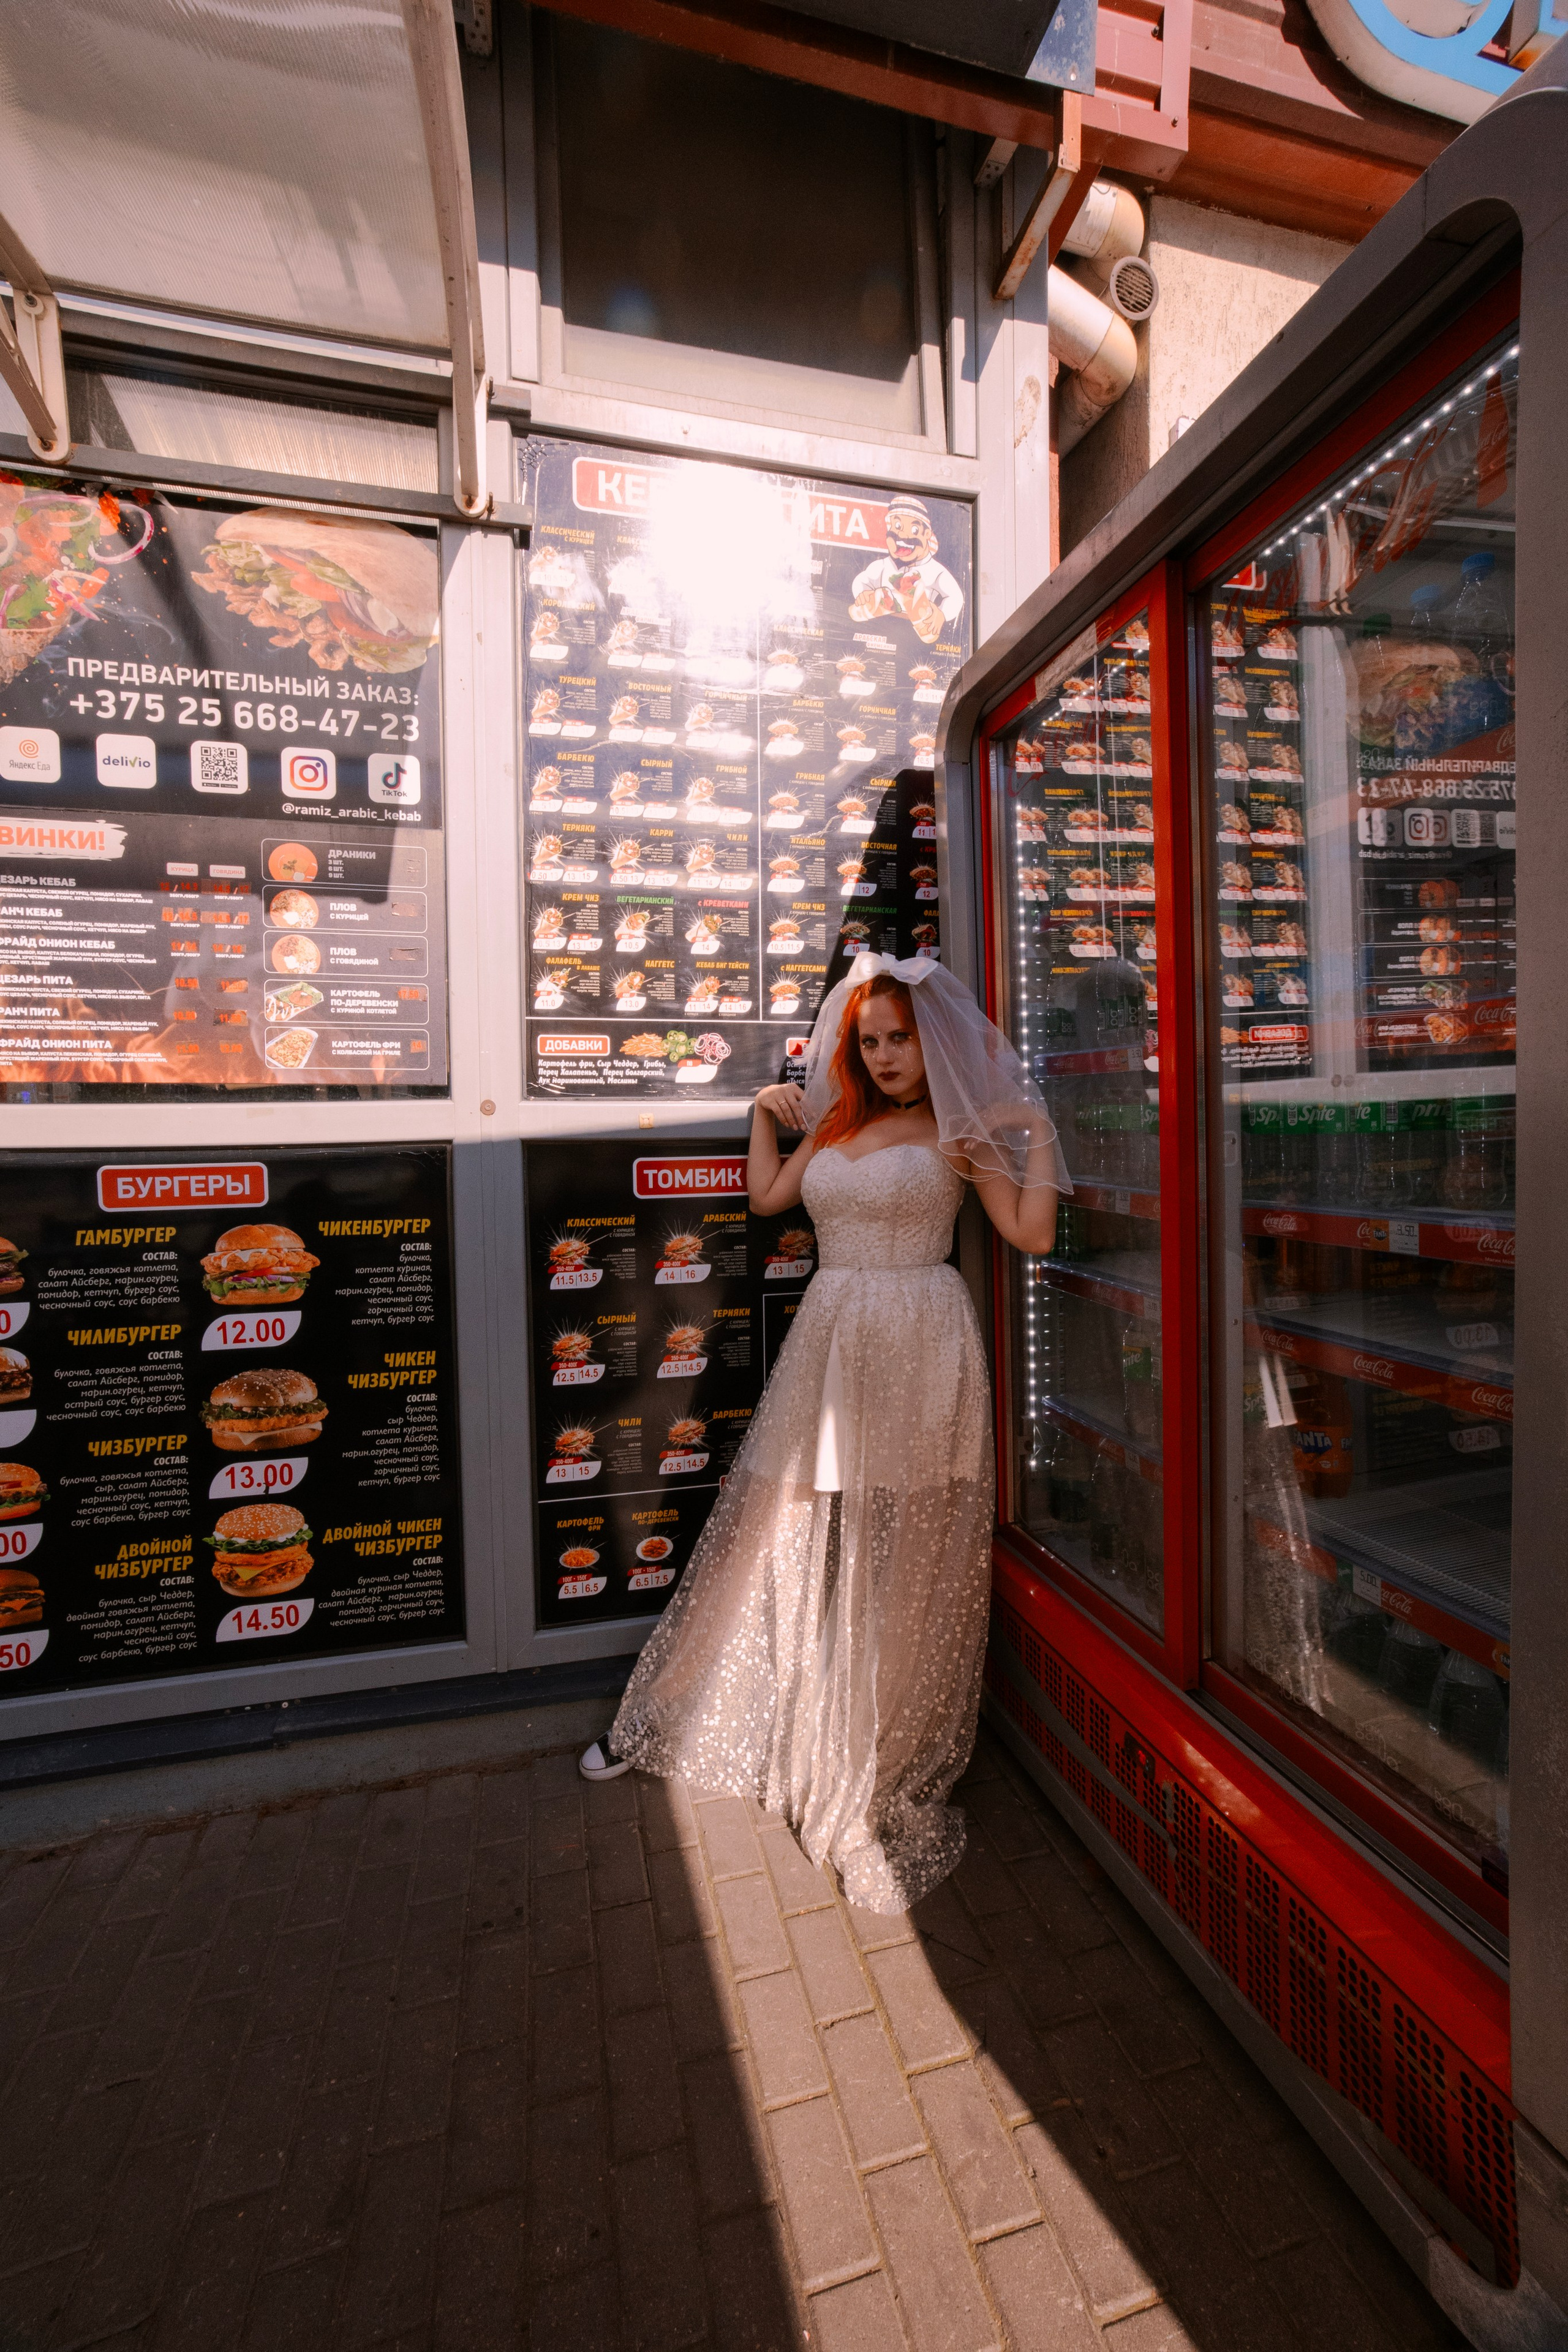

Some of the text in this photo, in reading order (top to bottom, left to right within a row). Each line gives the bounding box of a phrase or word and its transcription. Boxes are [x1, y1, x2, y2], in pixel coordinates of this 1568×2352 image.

[806, 502, 869, 540] ИТА
[68, 657, 420, 706] ПРЕДВАРИТЕЛЬНЫЙ ЗАКАЗ:
[559, 675, 597, 686] ТУРЕЦКИЙ
[628, 682, 672, 693] ВОСТОЧНЫЙ
[70, 689, 420, 742] +375 25 668-47-23
[102, 755, 151, 768] delivio
[557, 752, 595, 763] БАРБЕКЮ
[640, 758, 673, 768] СЫРНЫЙ
[9, 759, 51, 771] Яндекс Еда
[796, 772, 826, 782] ГРИБНАЯ
[870, 778, 896, 787] СЫРНАЯ
[282, 802, 422, 823] @ramiz_arabic_kebab
[562, 823, 595, 833] ТЕРИЯКИ
[649, 828, 674, 837] КАРРИ
[726, 833, 748, 842] ЧИЛИ
[861, 842, 897, 851] ВОСТОЧНАЯ
[328, 849, 376, 859] ДРАНИКИ
[0, 875, 77, 887] ЕЗАРЬ КЕБАБ
[562, 892, 600, 902] КРЕМ ЧИЗ
[616, 895, 674, 905] ВЕГЕТАРИАНСКИЙ
[330, 902, 357, 911] ПЛОВ
[811, 903, 826, 911] ЧИЗ
[335, 913, 369, 921] КУРИЦЕЙ
[852, 945, 860, 954] 10
[545, 957, 582, 967] ФАЛАФЕЛЬ
[644, 959, 675, 968] НАГГЕТС
[330, 989, 380, 998] КАРТОФЕЛЬ
[330, 998, 399, 1008] ПО-ДЕРЕВЕНСКИ
[29, 1007, 61, 1017] ПИТА
[42, 1039, 81, 1049] ОНИОН
[82, 1039, 113, 1049] ПИТА
[545, 1039, 603, 1052] ДОБАВКИ
[538, 1059, 666, 1070] Картофель фри, Сыр Чеддер, Грибы,
[643, 1167, 742, 1189] ТОМБИК
[117, 1174, 251, 1199] БУРГЕРЫ
[567, 1215, 635, 1227] КЛАССИЧЕСКИЙ
[703, 1213, 747, 1223] АРАБСКИЙ
[318, 1218, 431, 1238] ЧИКЕНБУРГЕР
[75, 1226, 176, 1248] ГАМБУРГЕР
[401, 1242, 432, 1251] СОСТАВ:
[142, 1251, 178, 1261] СОСТАВ:
[399, 1253, 432, 1264] булочка,
[48, 1267, 86, 1278] булочка,
[134, 1264, 178, 1273] котлета,
[396, 1265, 432, 1274] куриная,
[685, 1270, 696, 1279] 16
[70, 1276, 111, 1287] Айсберг,
[398, 1273, 432, 1283] Айсберг,
[556, 1275, 574, 1285] 11.5
[578, 1272, 597, 1283] 13.5
[665, 1271, 675, 1281] 14
[37, 1286, 179, 1300] помидор, кетчуп, бургер соус,
[396, 1283, 433, 1293] помидор,
[39, 1294, 180, 1310] чесночный соус, соус барбекю
[368, 1294, 434, 1304] чесночный соус,
[367, 1305, 434, 1316] горчичный соус,
[712, 1308, 750, 1317] ТЕРИЯКИ
[351, 1314, 435, 1327] кетчуп, бургер соус
[597, 1312, 636, 1325] СЫРНЫЙ
[67, 1324, 182, 1346] ЧИЛИБУРГЕР
[217, 1317, 285, 1344] 12.00
[384, 1351, 436, 1368] ЧИКЕН
[1353, 1355, 1395, 1379] Coca-Cola
[556, 1372, 575, 1382] 12.5
[579, 1368, 598, 1379] 14.5
[348, 1369, 437, 1390] ЧИЗБУРГЕР
[712, 1408, 752, 1420] БАРБЕКЮ
[618, 1417, 642, 1427] ЧИЛИ
[88, 1434, 187, 1457] ЧИЗБУРГЕР
[225, 1463, 293, 1490] 13.00
[556, 1468, 566, 1478] 13
[578, 1466, 590, 1476] 15
[557, 1517, 604, 1528] КАРТОФЕЛЬ
[322, 1518, 442, 1544] ДВОЙНОЙ ЧИКЕН
[116, 1534, 192, 1561] ДВОЙНОЙ
[355, 1534, 443, 1556] ЧИЗБУРГЕР
[412, 1556, 443, 1566] СОСТАВ:
[94, 1555, 194, 1580] ЧИЗБУРГЕР
[358, 1569, 443, 1586] булочка, сыр Чеддер,
[331, 1579, 443, 1597] двойная куриная котлета,
[564, 1585, 578, 1595] 5.5
[585, 1583, 598, 1593] 6.5
[318, 1600, 345, 1609] салат
[347, 1595, 383, 1605] Айсберг,
[338, 1605, 376, 1616] помидор,
[379, 1599, 423, 1613] горчичный
[232, 1604, 300, 1634] 14.50
[330, 1607, 445, 1627] чесночный соус, бургер соус
